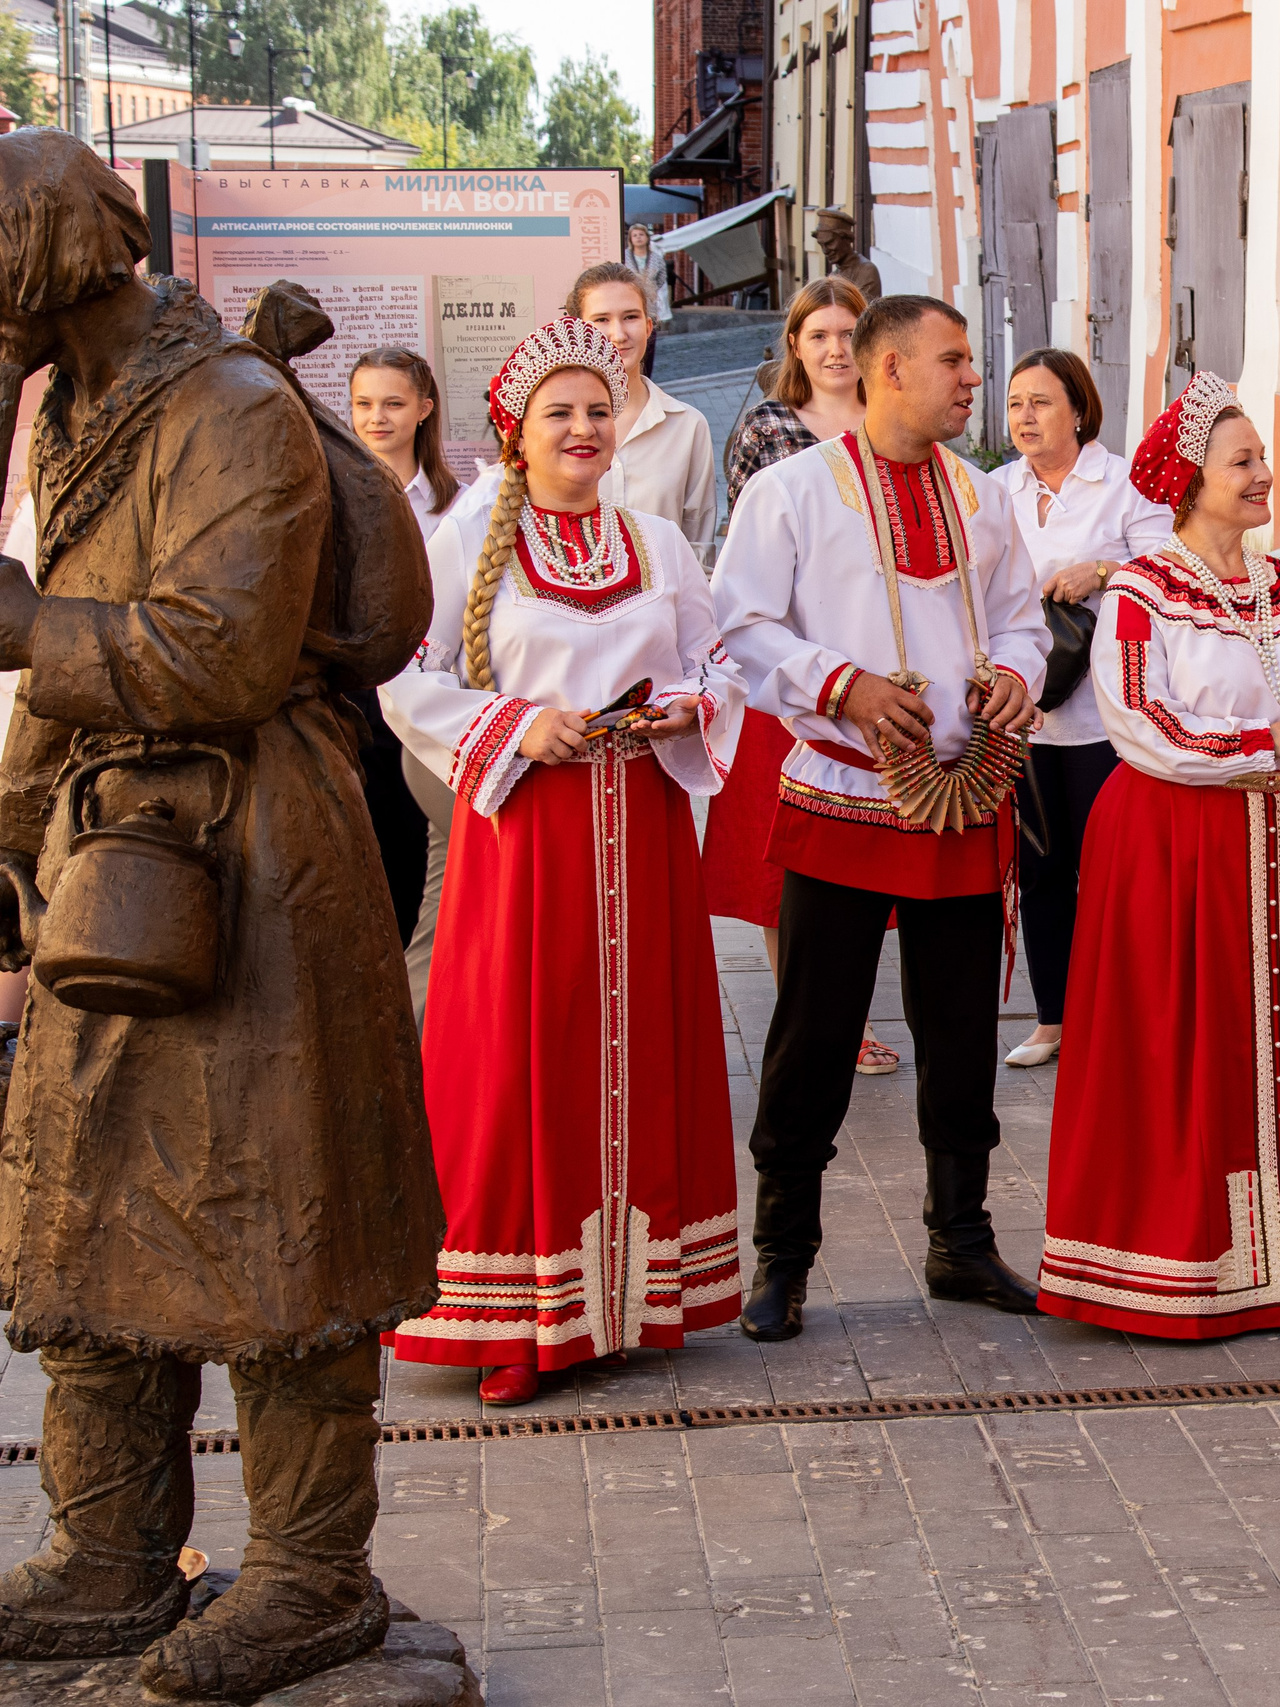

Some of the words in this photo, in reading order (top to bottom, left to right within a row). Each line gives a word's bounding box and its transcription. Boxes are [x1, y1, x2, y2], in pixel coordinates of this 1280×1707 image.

[219, 178, 370, 189] ВЫСТАВКА
[385, 175, 546, 191] МИЛЛИОНКА
[421, 191, 465, 212] НА
[473, 191, 570, 212] ВОЛГЕ
[211, 222, 315, 231] АНТИСАНИТАРНОЕ
[316, 222, 380, 231] СОСТОЯНИЕ
[382, 222, 442, 231] НОЧЛЕЖЕК
[443, 222, 513, 231] МИЛЛИОНКИ
[332, 285, 343, 293] Въ
[358, 294, 383, 304] факты
[442, 302, 495, 320] ДЕЛО
[457, 335, 516, 343] Нижегородского
[442, 345, 497, 354] ГОРОДСКОГО
[499, 345, 517, 353] СОВ
